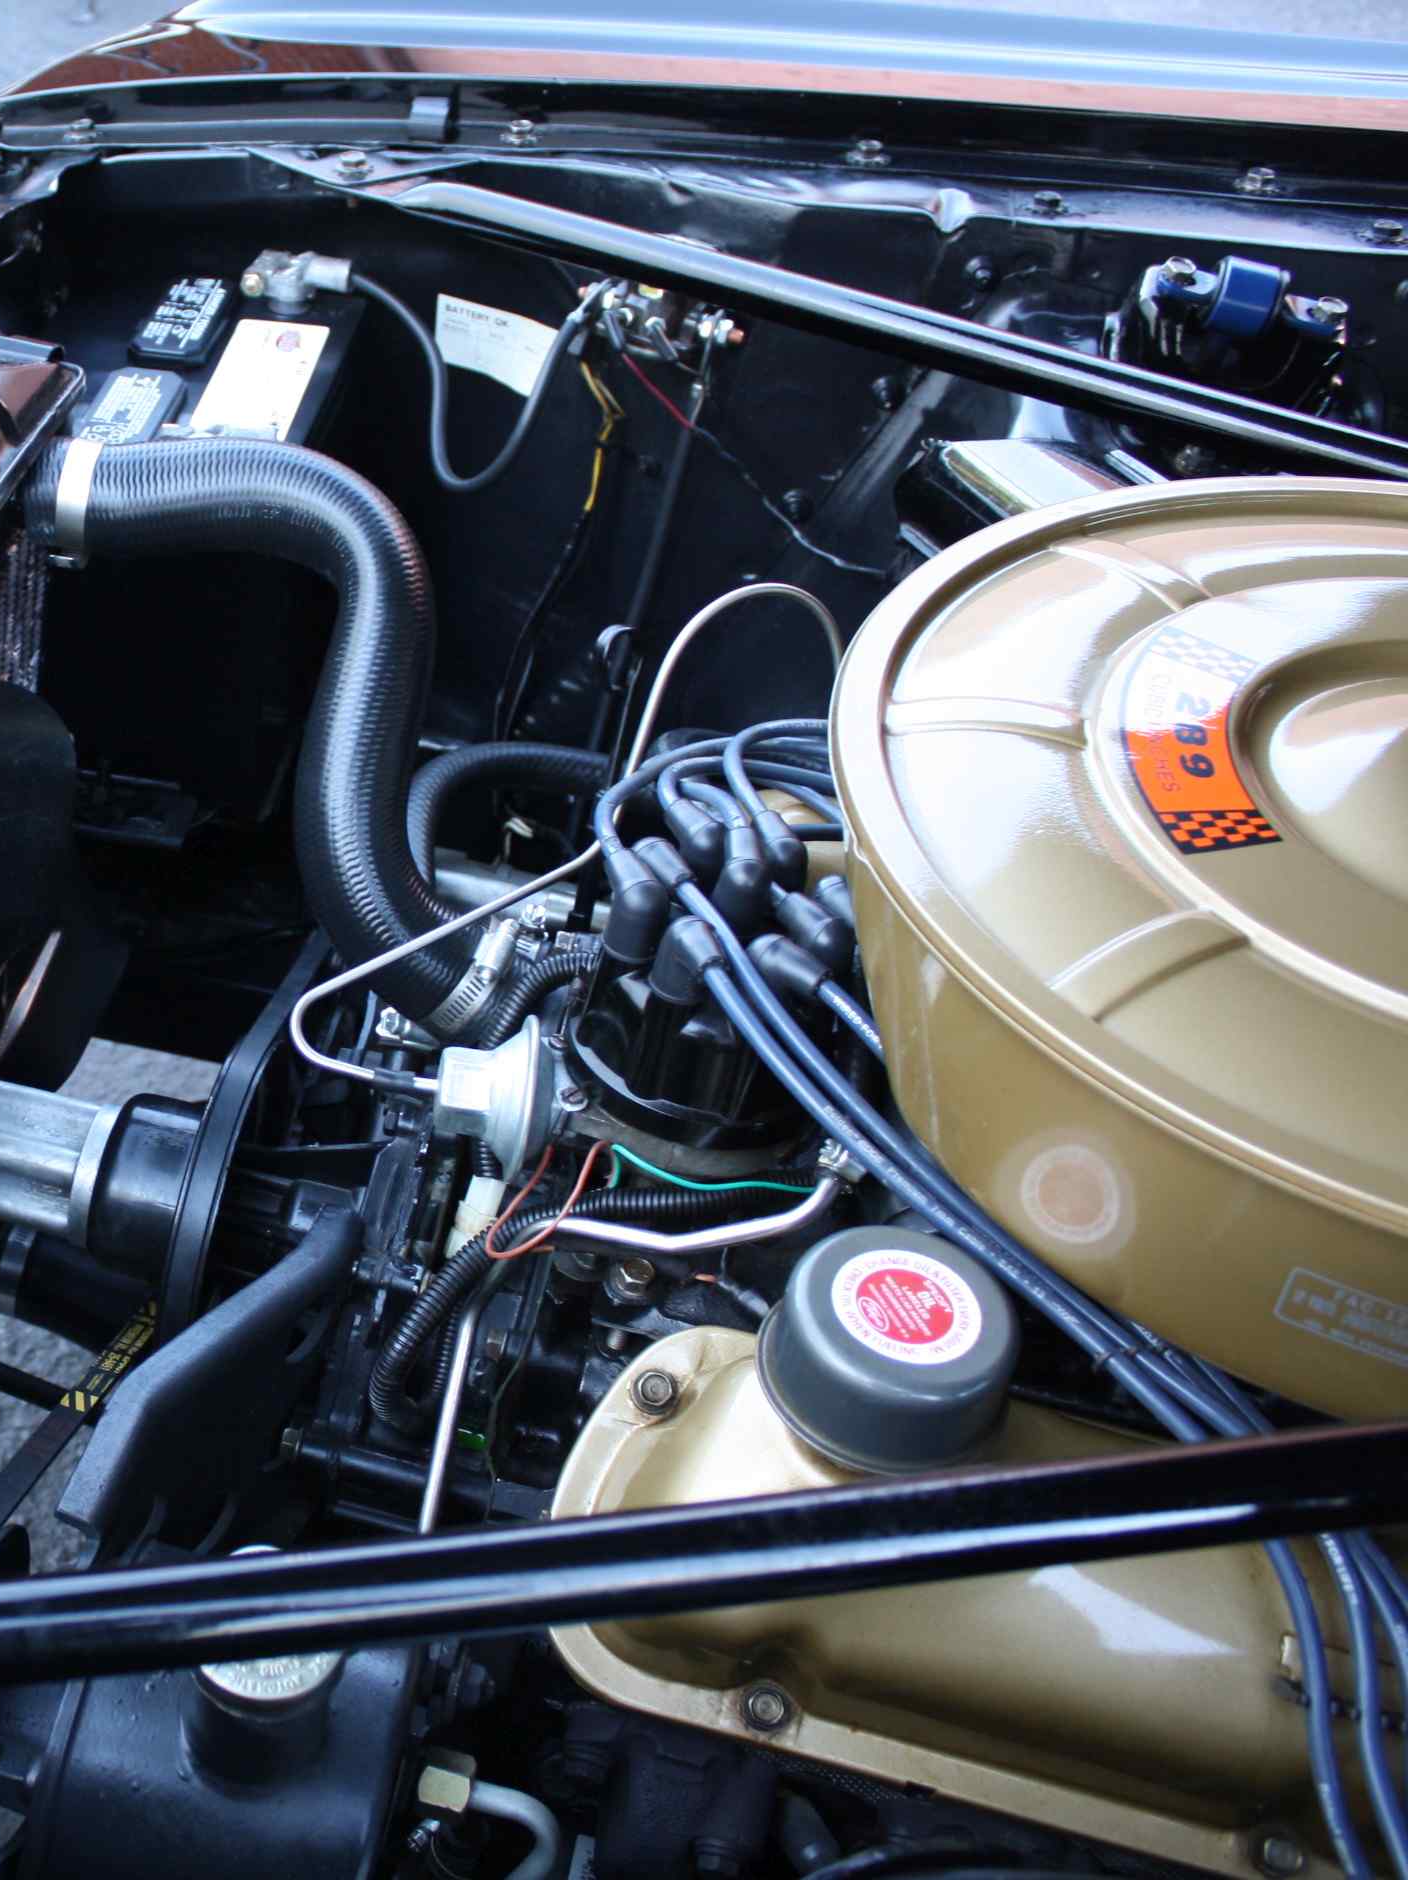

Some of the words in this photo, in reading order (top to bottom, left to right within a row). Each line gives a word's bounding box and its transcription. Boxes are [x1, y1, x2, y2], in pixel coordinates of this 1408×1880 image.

[445, 303, 490, 322] BATTERY
[1173, 692, 1216, 779] 289
[916, 1291, 937, 1309] OIL
